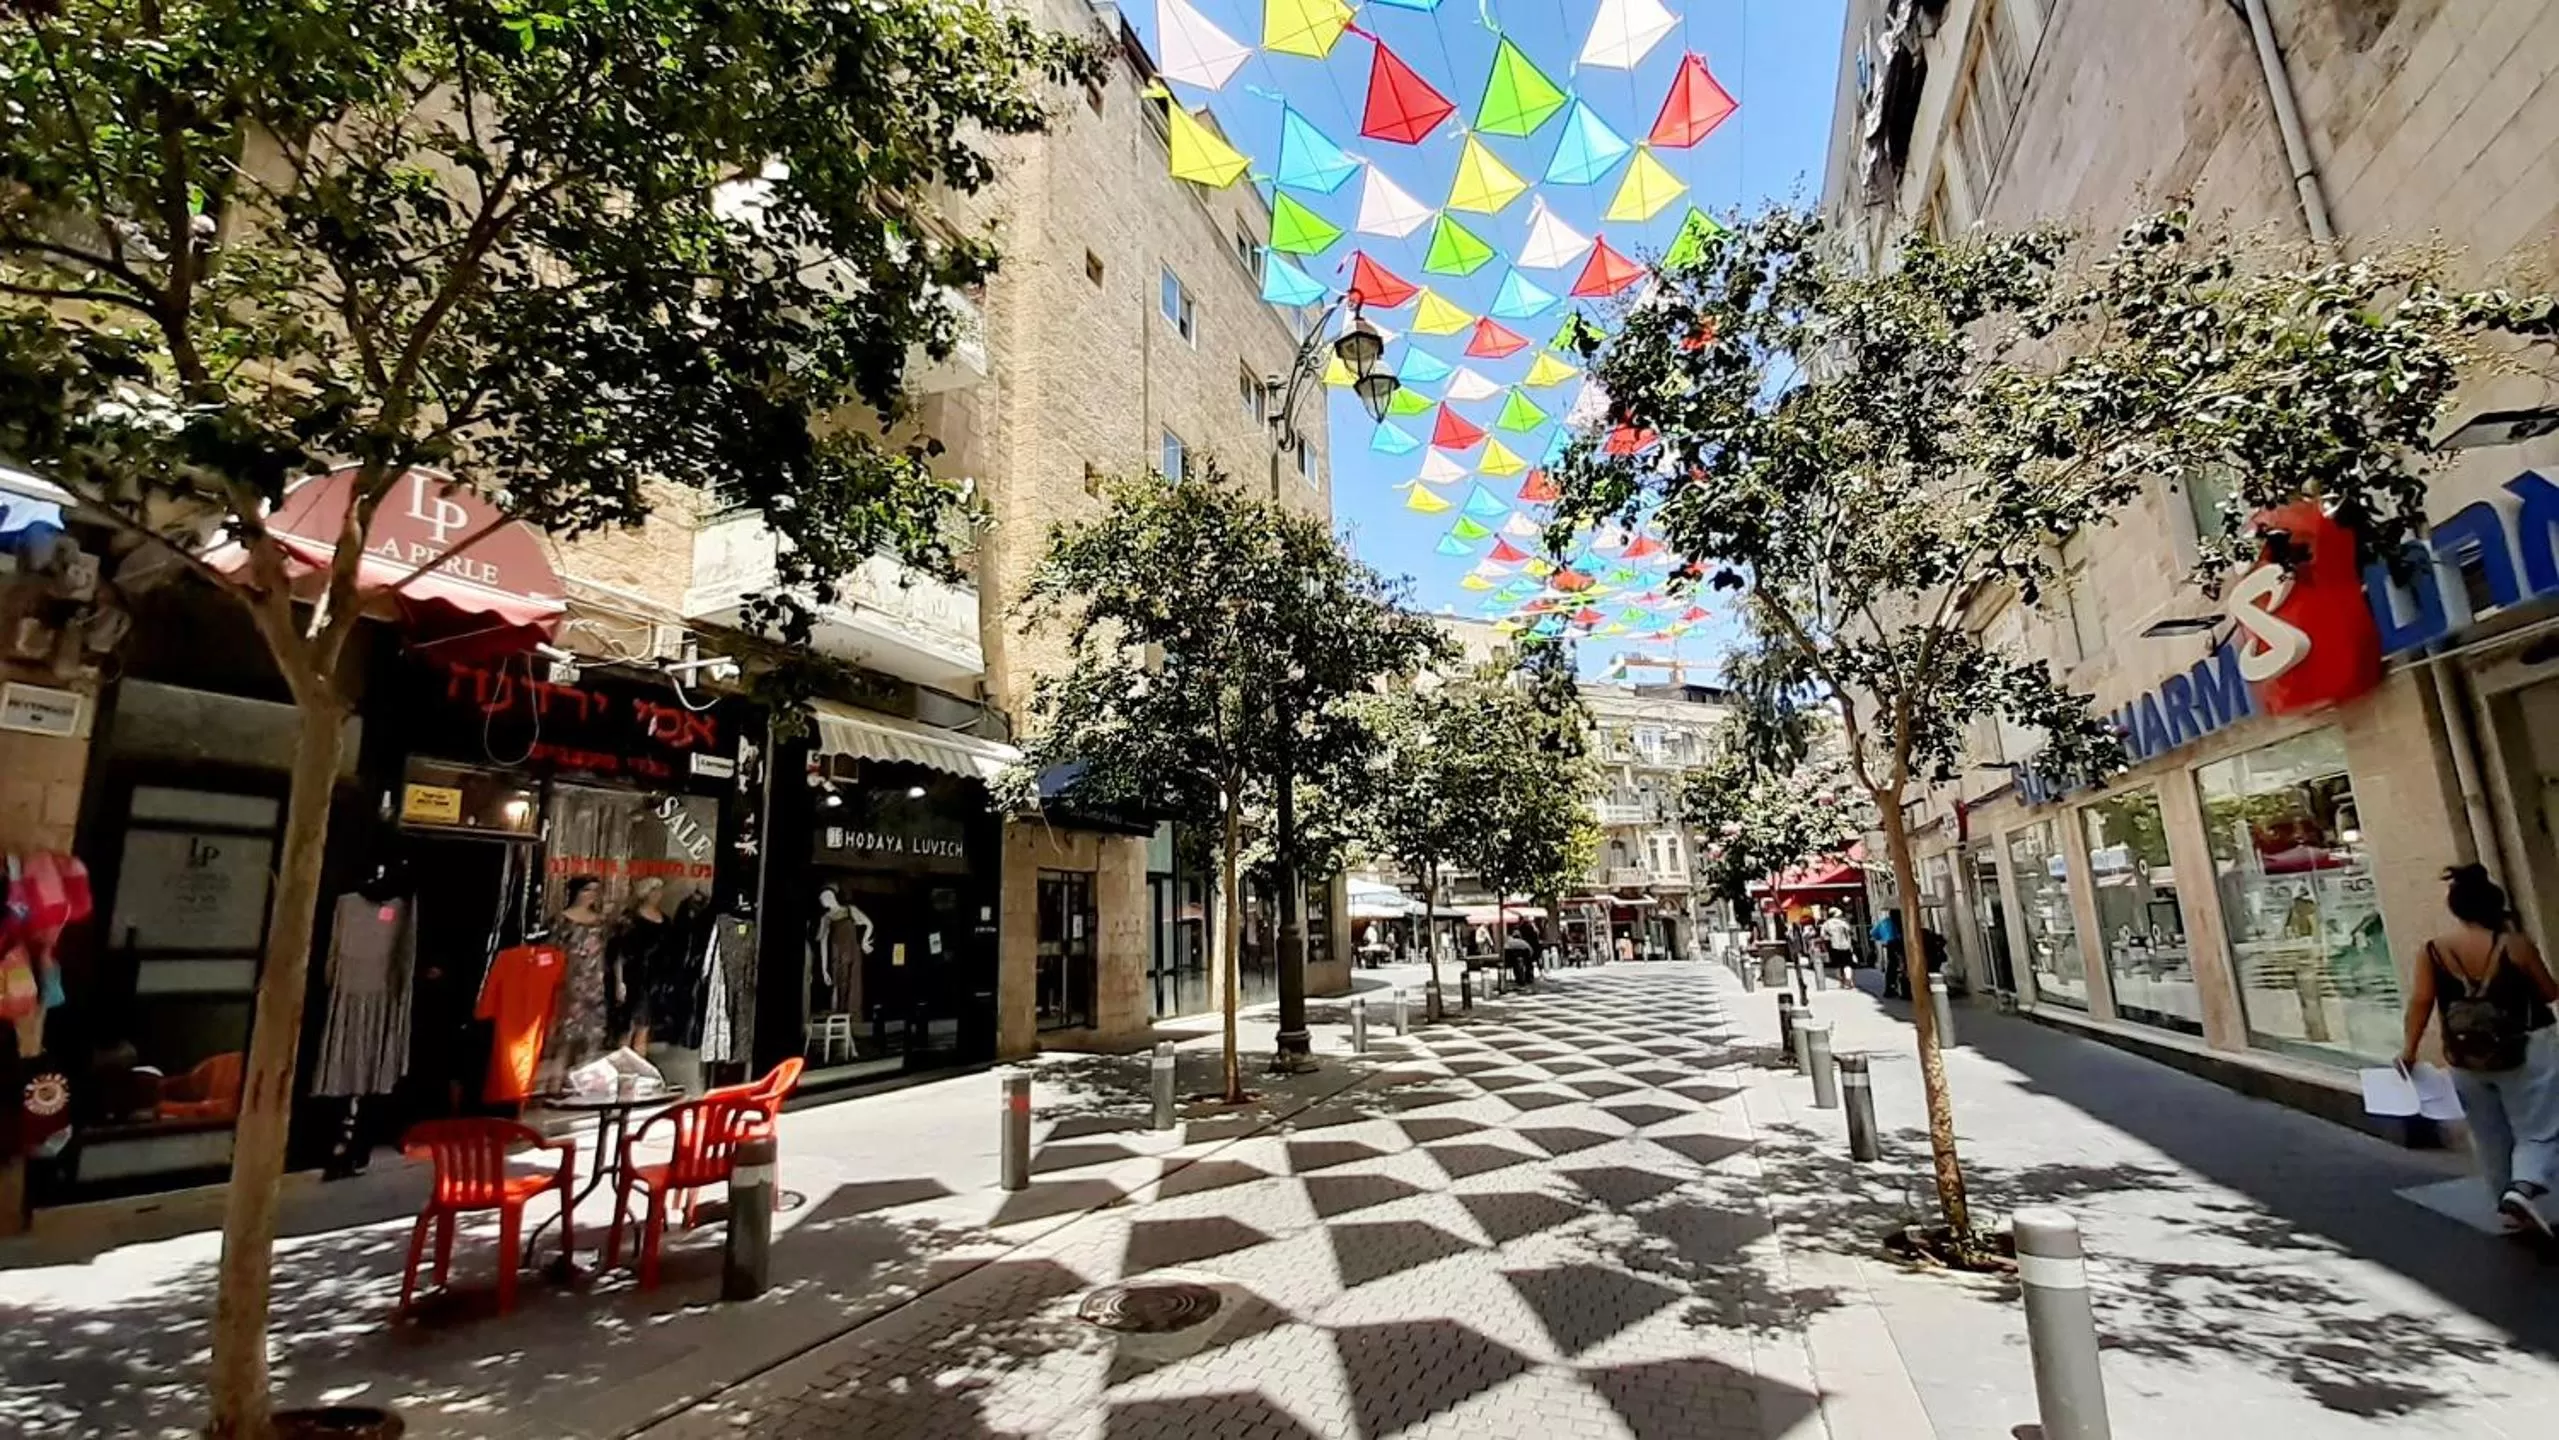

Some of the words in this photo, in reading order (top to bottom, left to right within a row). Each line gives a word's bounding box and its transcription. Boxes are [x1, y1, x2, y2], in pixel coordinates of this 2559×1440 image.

[405, 472, 468, 544] LP
[407, 541, 500, 586] PERLE
[2095, 641, 2251, 761] HARM
[655, 795, 713, 861] SALE
[845, 830, 903, 854] HODAYA
[912, 836, 964, 858] LUVICH
